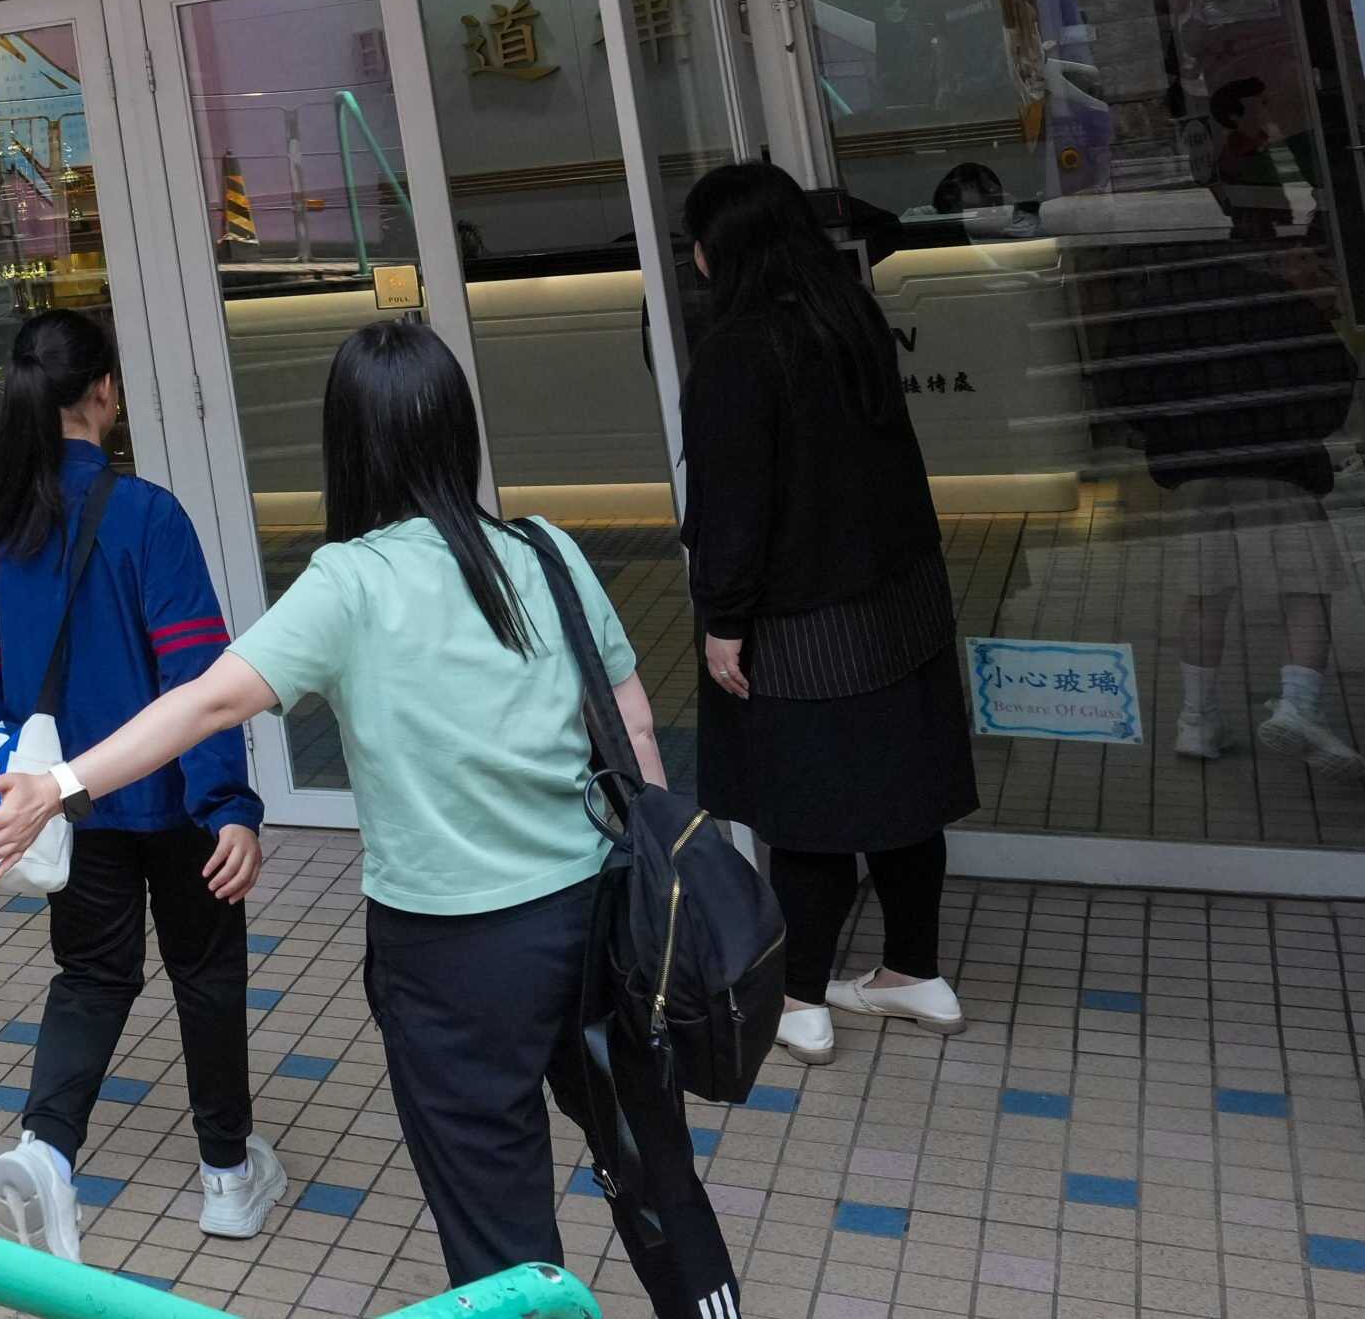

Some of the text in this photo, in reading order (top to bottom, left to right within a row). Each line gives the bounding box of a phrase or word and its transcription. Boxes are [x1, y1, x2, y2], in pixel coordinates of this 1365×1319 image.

[987, 666, 1120, 696] 小心玻璃
[993, 700, 1125, 720] Beware Of Glass
